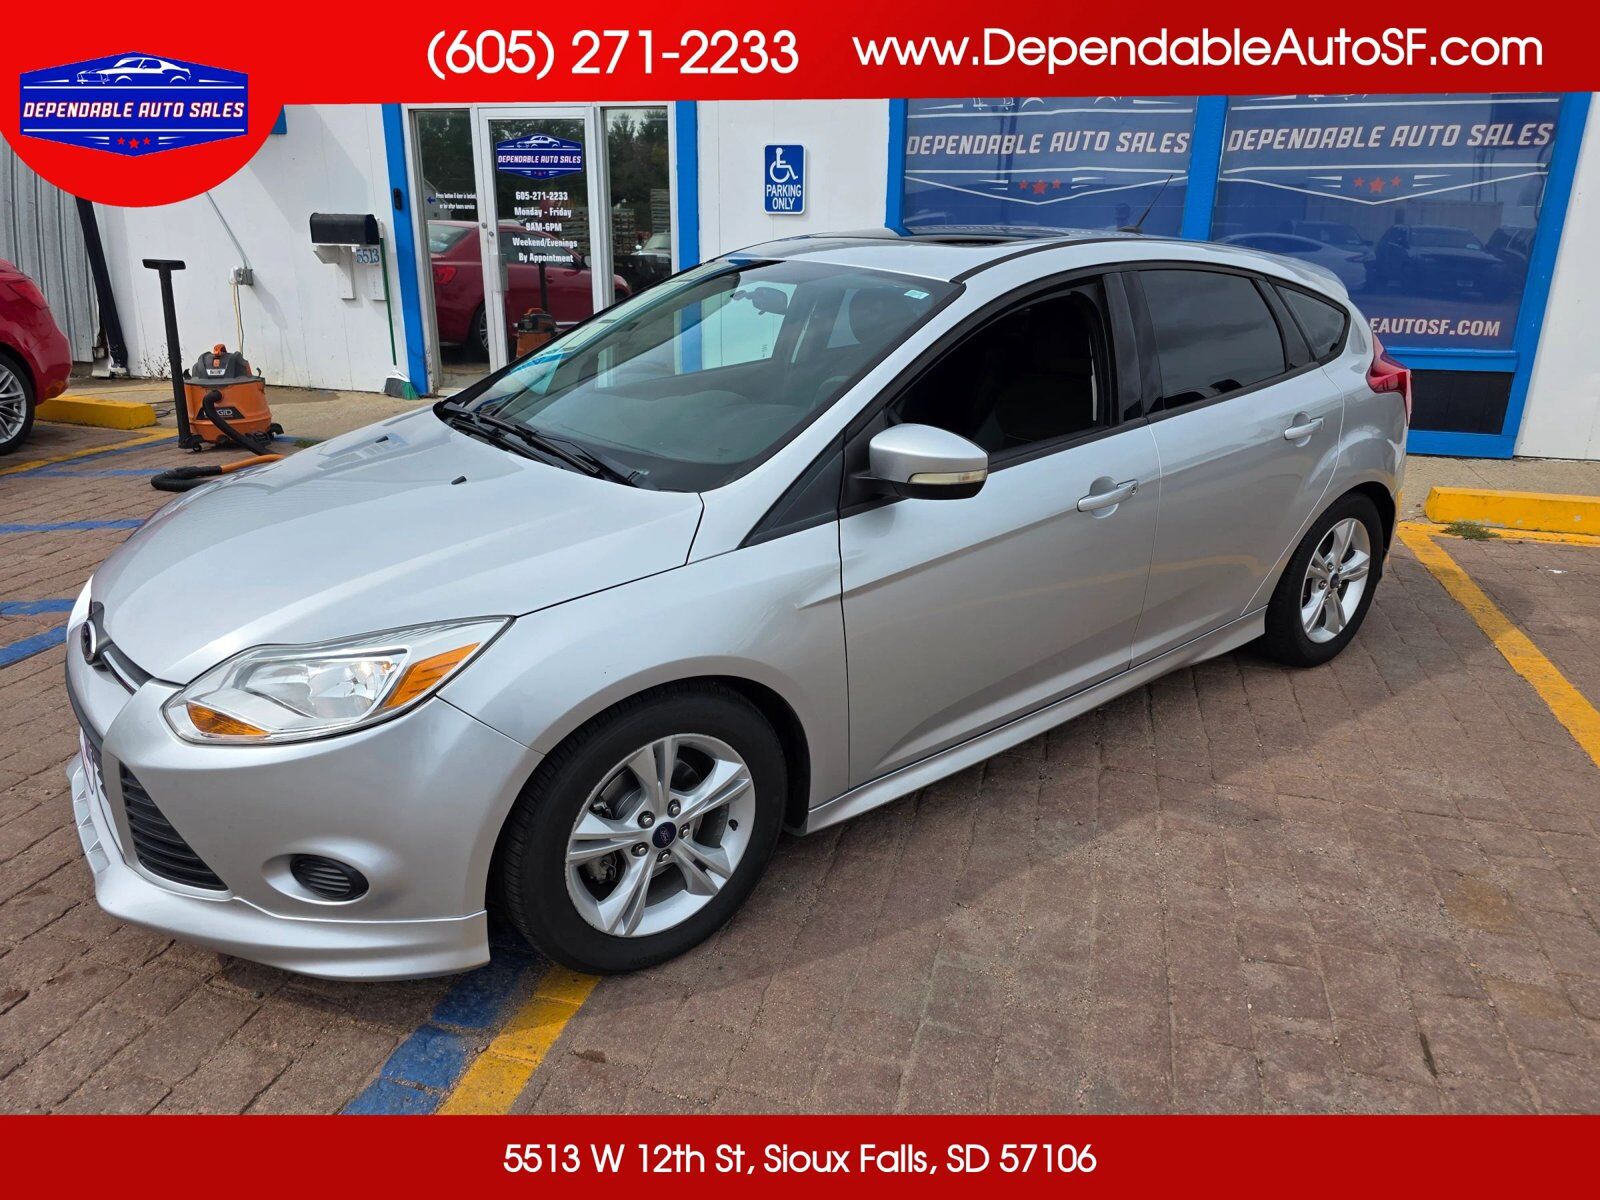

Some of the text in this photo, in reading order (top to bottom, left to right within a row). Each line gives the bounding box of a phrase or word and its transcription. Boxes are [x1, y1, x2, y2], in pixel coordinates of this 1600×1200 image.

[906, 131, 1191, 155] DEPENDABLE AUTO SALES
[1227, 123, 1553, 152] DEPENDABLE AUTO SALES
[498, 155, 581, 163] DEPENDABLE AUTO SALES
[515, 191, 568, 200] 605-271-2233
[766, 184, 801, 197] PARKING
[772, 197, 795, 210] ONLY
[514, 206, 543, 217] Monday
[549, 207, 572, 218] Friday
[525, 222, 562, 232] 9AM-6PM
[512, 237, 578, 249] Weekend/Evenings
[356, 247, 380, 264] 5513
[518, 252, 574, 264] By Appointment
